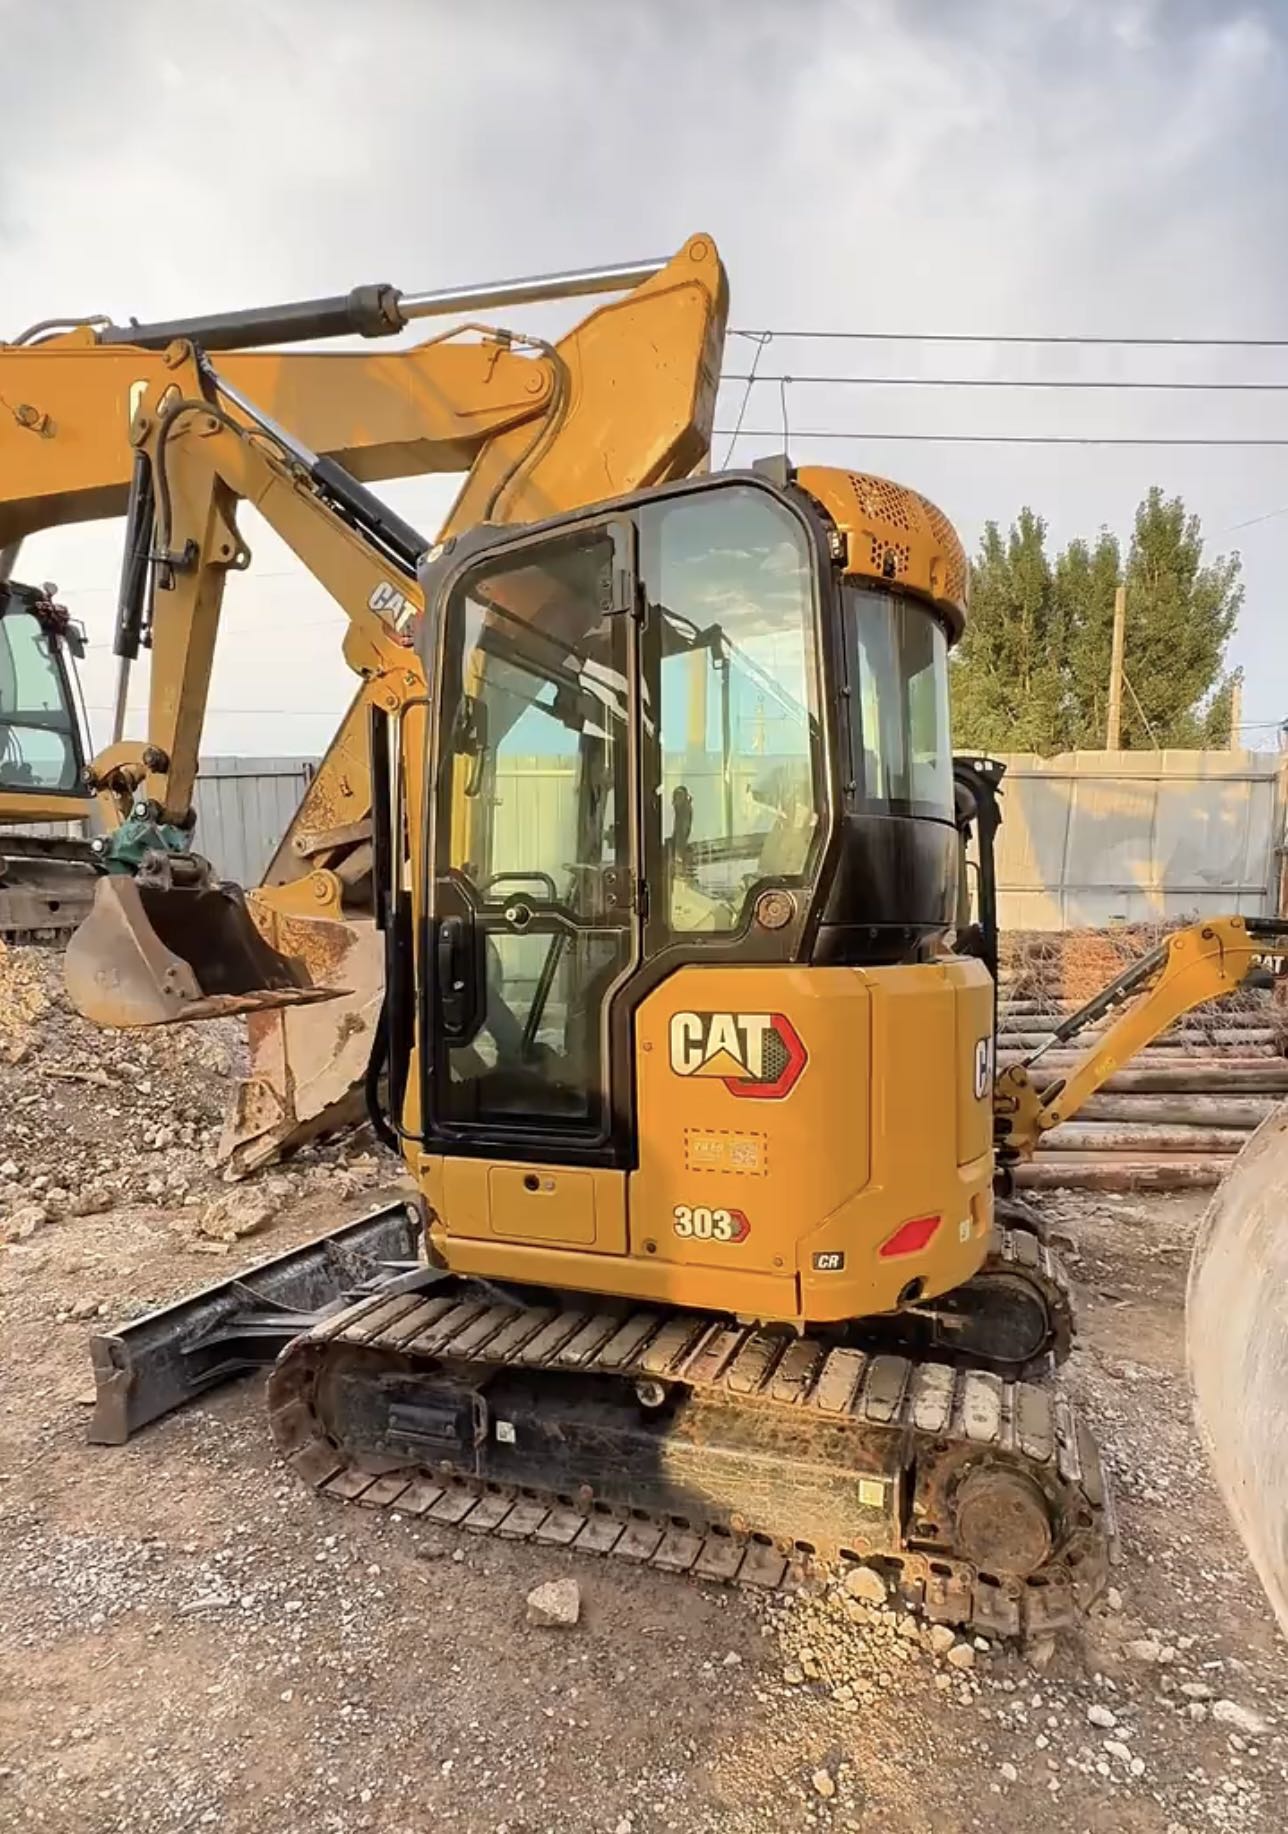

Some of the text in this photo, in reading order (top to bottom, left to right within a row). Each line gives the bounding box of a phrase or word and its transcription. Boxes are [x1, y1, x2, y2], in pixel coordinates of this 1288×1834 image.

[369, 582, 417, 632] CAT
[671, 1012, 771, 1078] CAT
[674, 1206, 732, 1241] 303
[818, 1255, 839, 1268] CR
